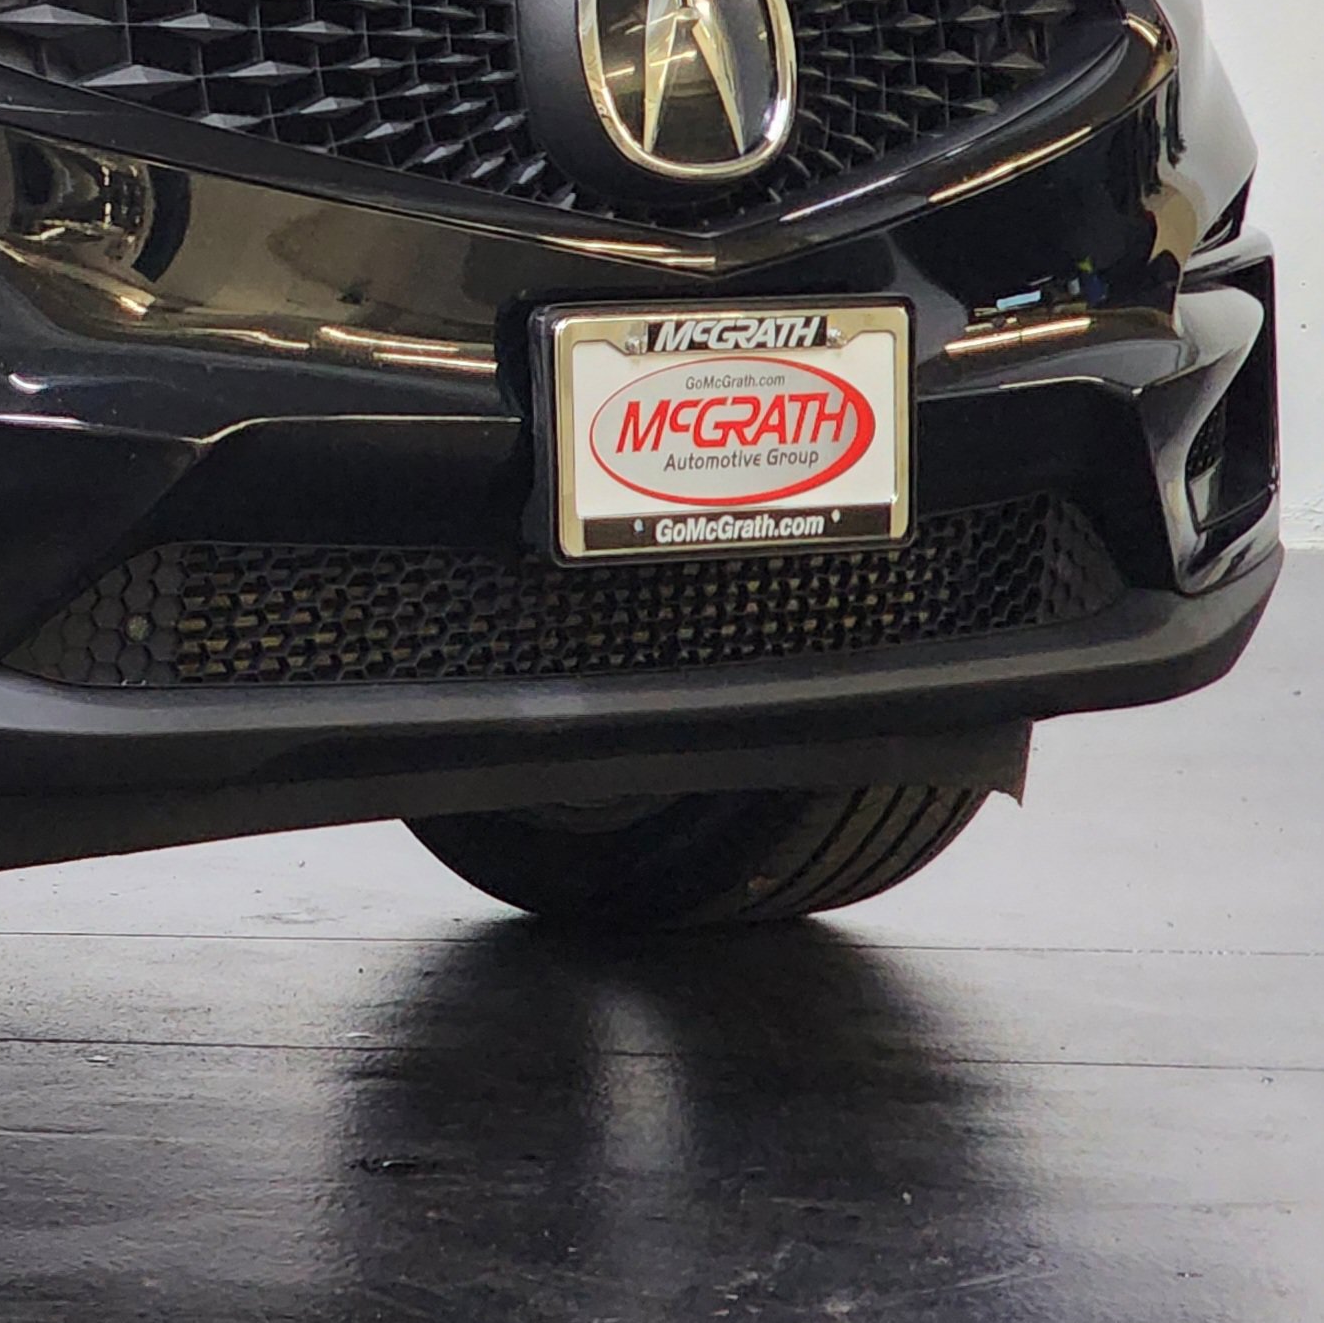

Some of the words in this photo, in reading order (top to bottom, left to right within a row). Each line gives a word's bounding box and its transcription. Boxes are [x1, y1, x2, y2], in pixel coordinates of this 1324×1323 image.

[685, 374, 785, 390] GoMcGrath.com
[664, 451, 761, 471] Automotive
[767, 449, 819, 468] Group
[656, 516, 824, 543] GoMcGrath.com
